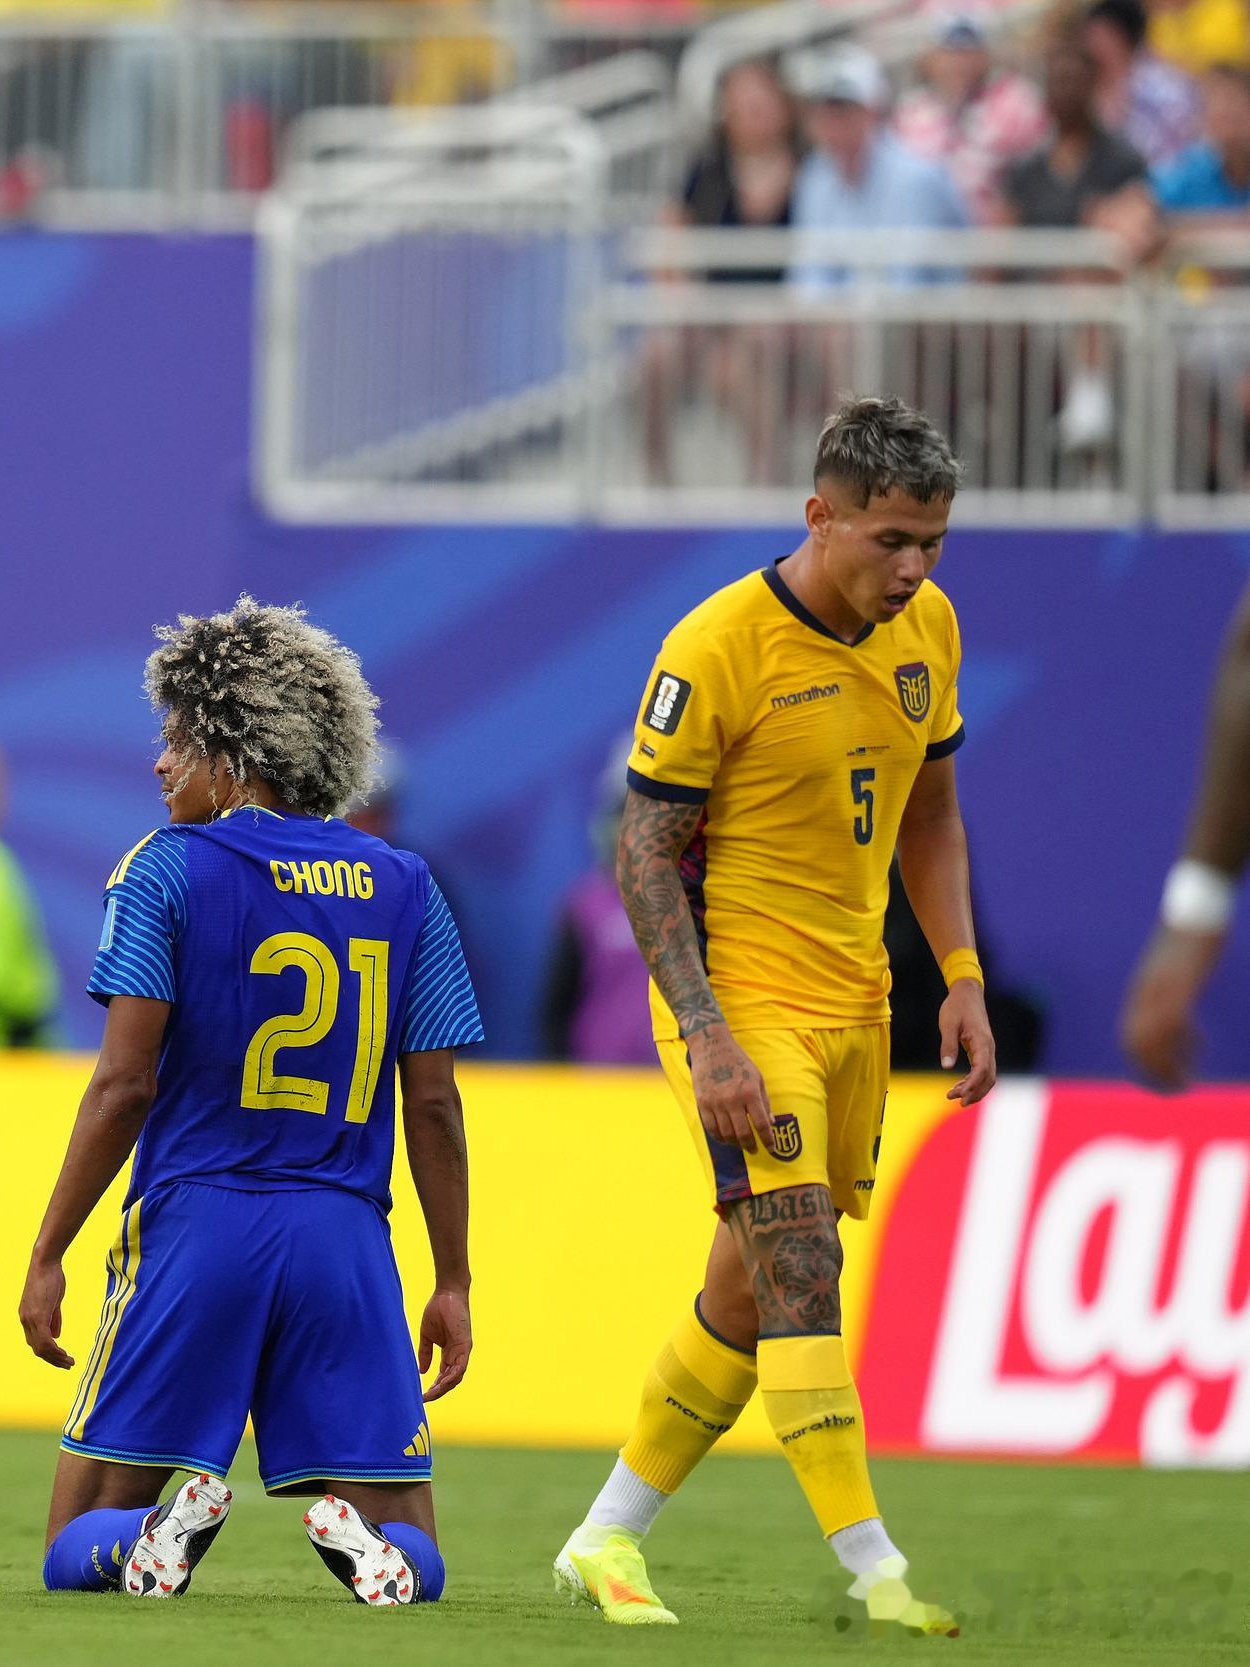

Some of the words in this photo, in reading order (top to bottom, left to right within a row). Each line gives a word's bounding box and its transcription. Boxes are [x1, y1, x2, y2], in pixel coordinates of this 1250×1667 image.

[771, 683, 841, 709] marathon
[851, 767, 876, 846] 5
[269, 859, 375, 900] CHONG
[240, 931, 390, 1124] 21
[781, 1414, 855, 1445] marathon
